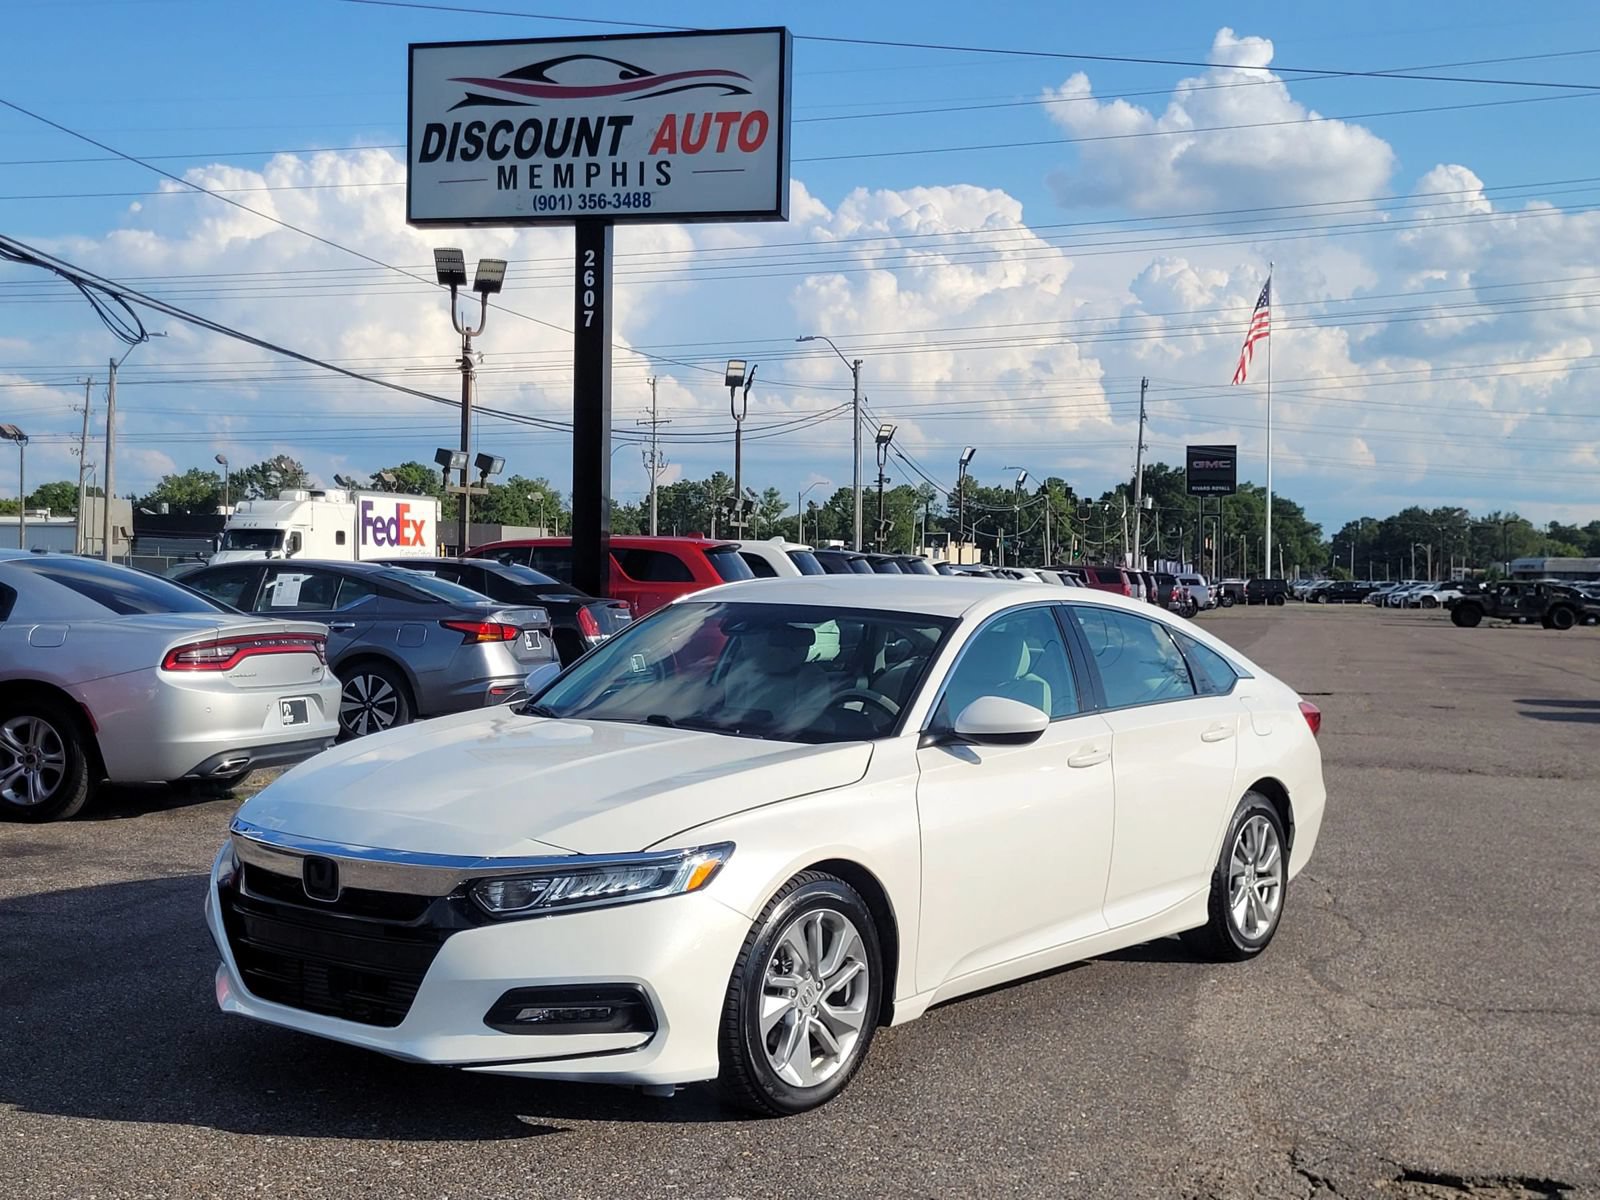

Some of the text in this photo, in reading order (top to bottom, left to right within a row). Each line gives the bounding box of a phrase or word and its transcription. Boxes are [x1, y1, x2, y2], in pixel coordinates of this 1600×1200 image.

[419, 110, 769, 163] DISCOUNT AUTO
[497, 160, 671, 190] MEMPHIS
[533, 192, 652, 211] (901) 356-3488
[583, 249, 595, 327] 2607
[1193, 460, 1231, 468] GMC
[361, 500, 426, 547] FedEx
